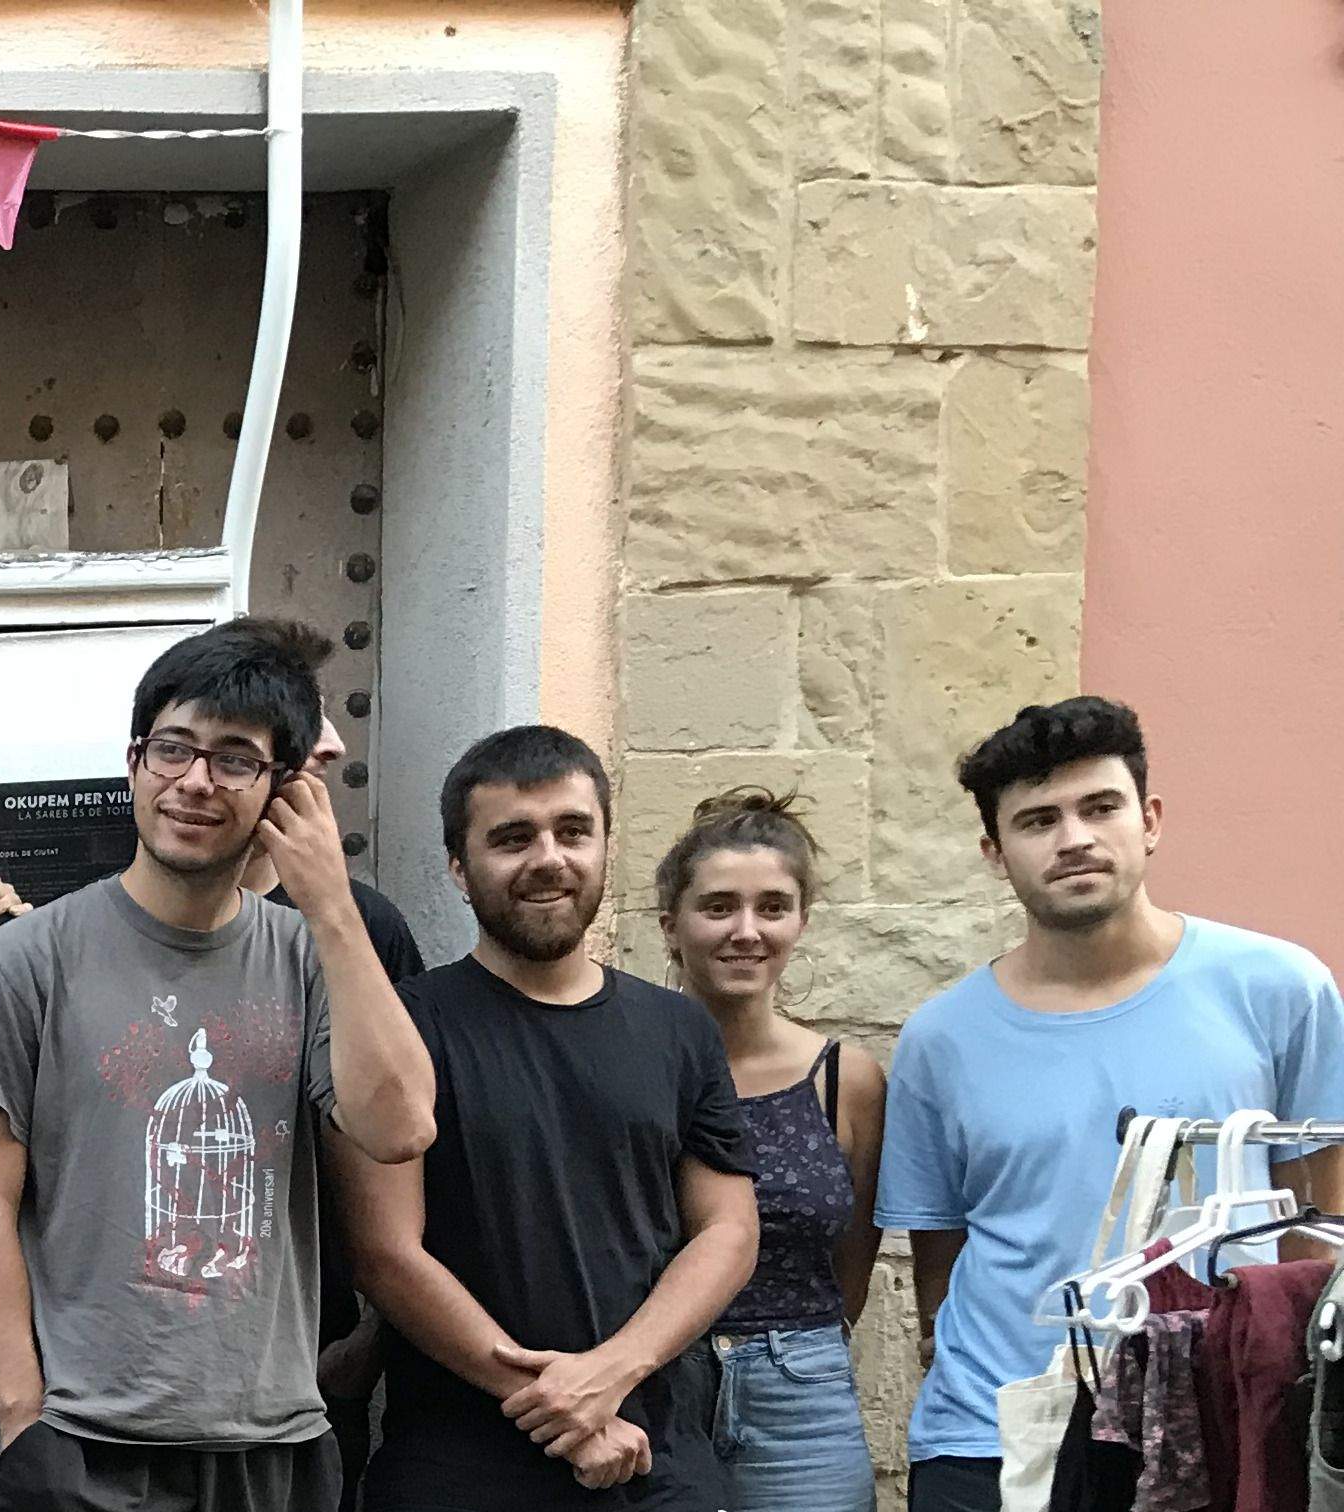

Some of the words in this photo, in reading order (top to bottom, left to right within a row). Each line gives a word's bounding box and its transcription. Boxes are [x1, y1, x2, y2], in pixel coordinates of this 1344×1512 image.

[4, 793, 70, 810] OKUPEM
[75, 792, 103, 807] PER
[106, 791, 133, 804] VIU
[18, 812, 32, 821] LA
[36, 809, 69, 820] SAREB
[89, 808, 102, 818] DE
[262, 1169, 275, 1218] aniversari
